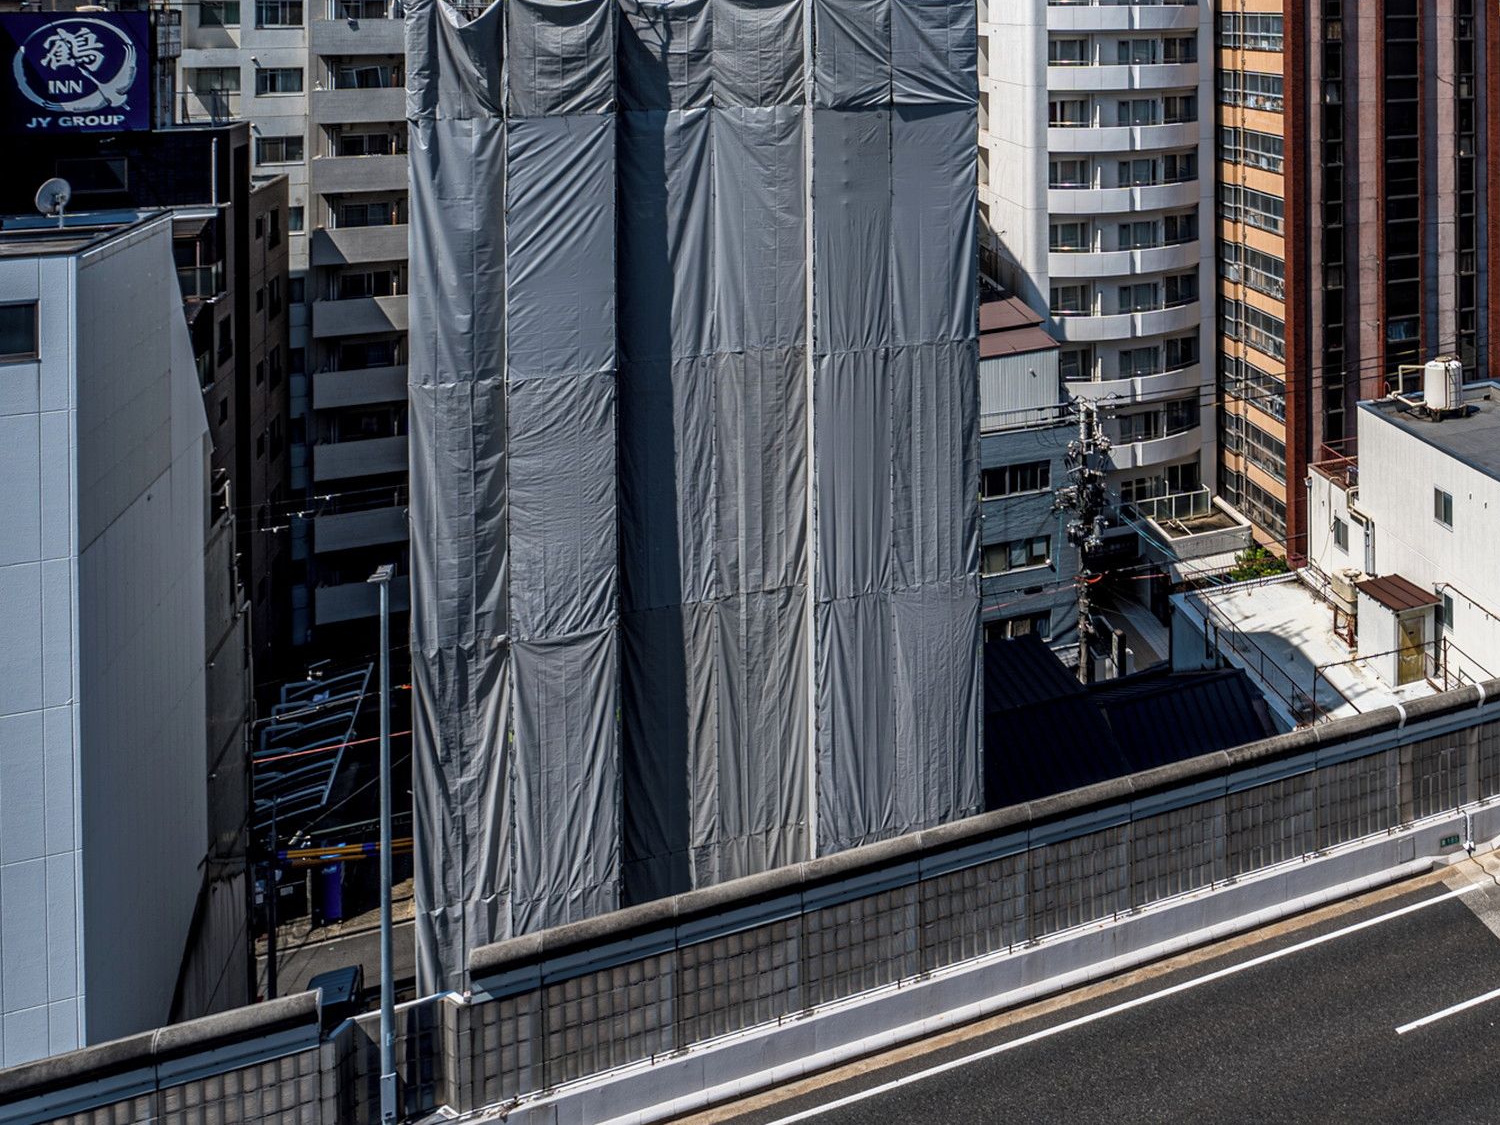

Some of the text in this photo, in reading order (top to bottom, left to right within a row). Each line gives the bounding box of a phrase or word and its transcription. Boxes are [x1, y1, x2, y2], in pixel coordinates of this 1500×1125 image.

[40, 27, 105, 71] 鶴
[48, 80, 83, 94] INN
[26, 115, 125, 128] JY GROUP
